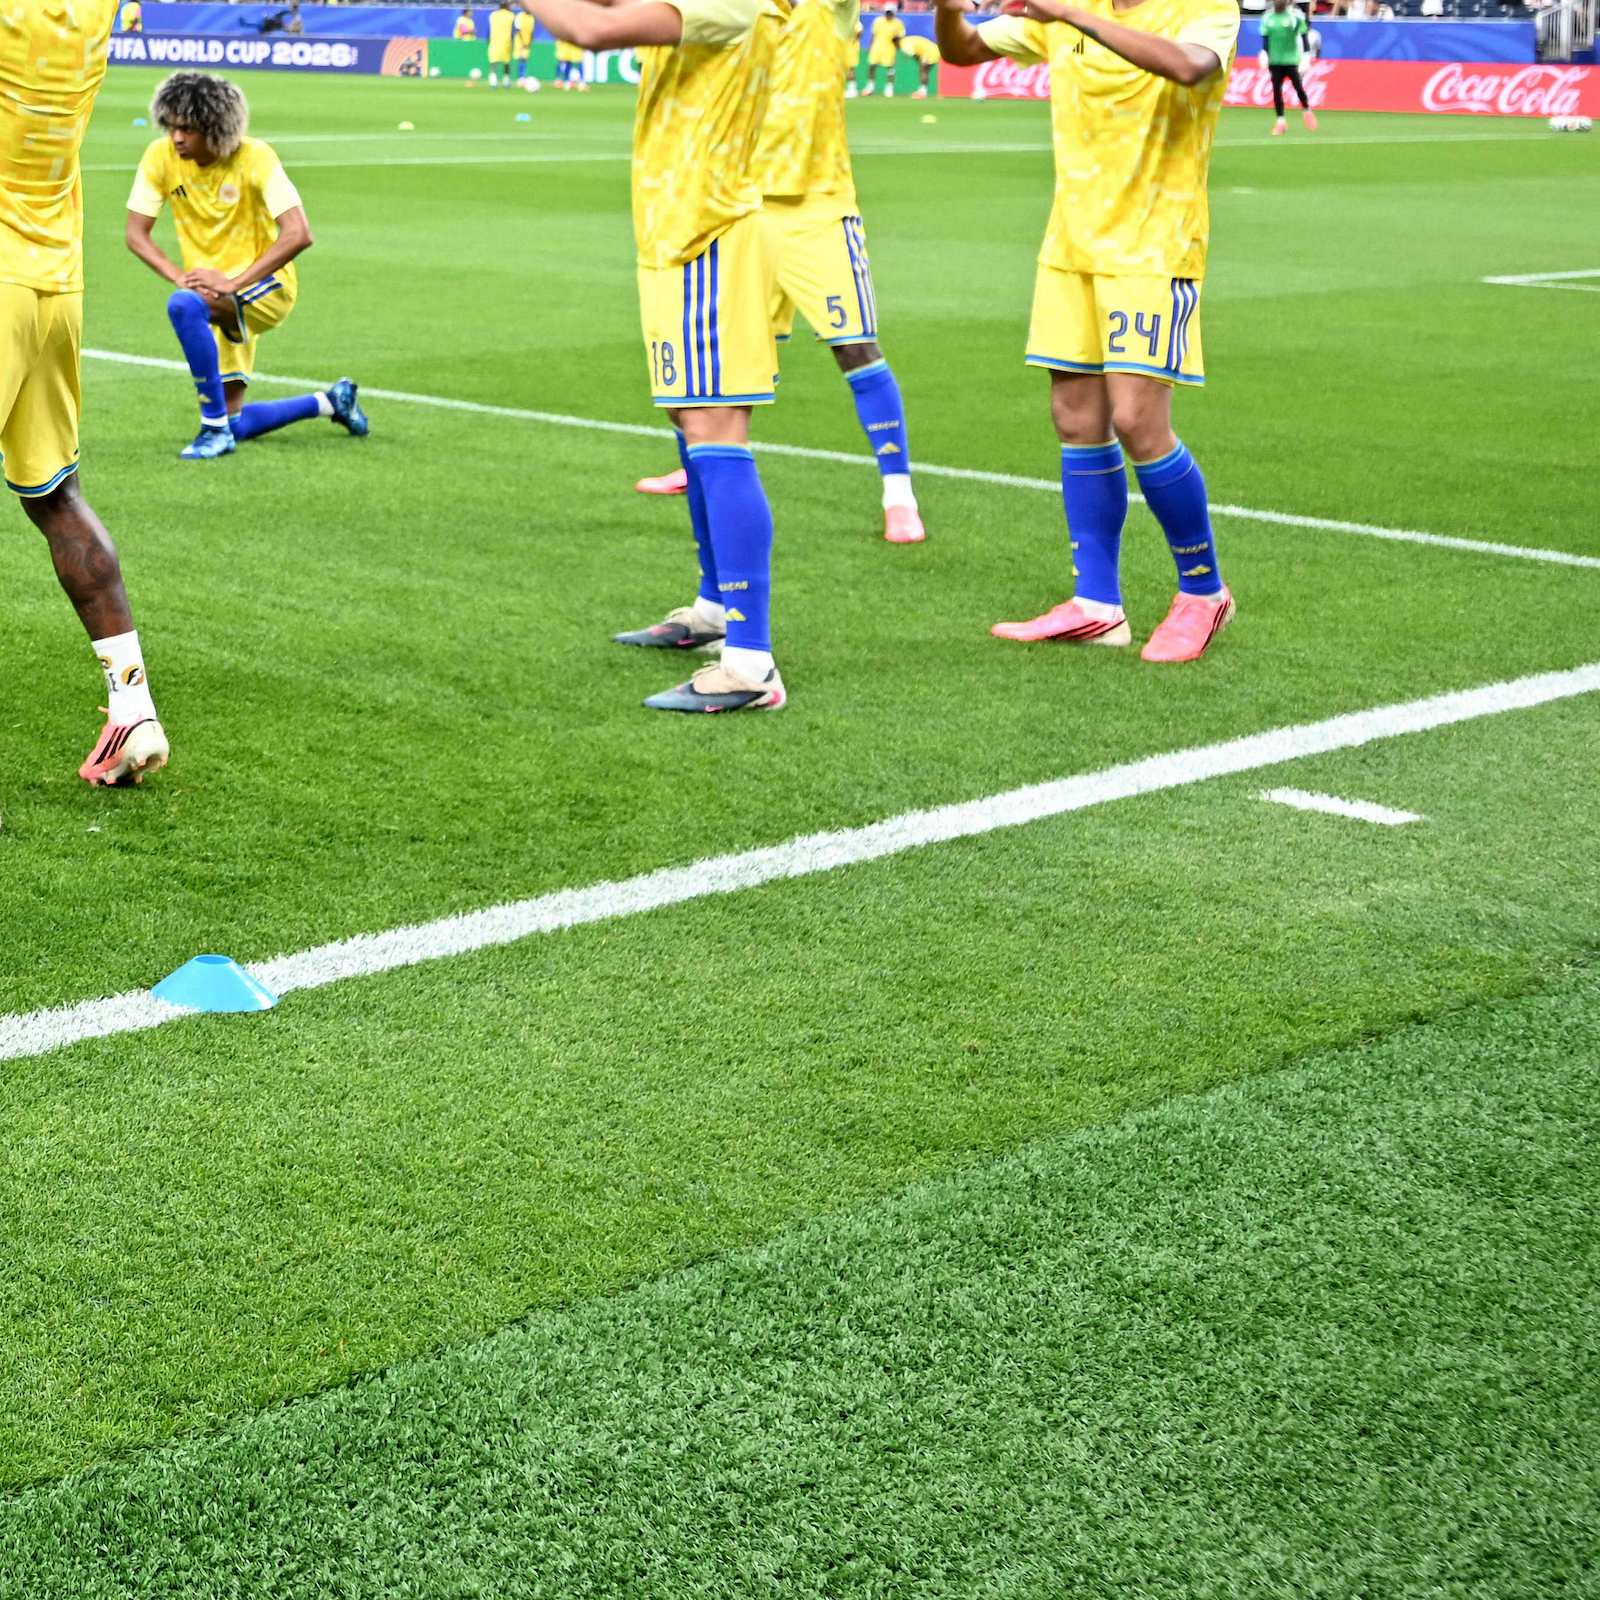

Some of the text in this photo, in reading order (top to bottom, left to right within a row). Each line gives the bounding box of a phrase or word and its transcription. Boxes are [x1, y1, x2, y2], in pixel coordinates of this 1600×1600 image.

[107, 37, 146, 60] FIFA
[147, 38, 224, 63] WORLD
[225, 41, 272, 64] CUP
[271, 43, 351, 67] 2026
[1422, 62, 1591, 115] Coca-Cola
[826, 295, 848, 329] 5
[1109, 311, 1161, 357] 24
[653, 341, 677, 386] 18
